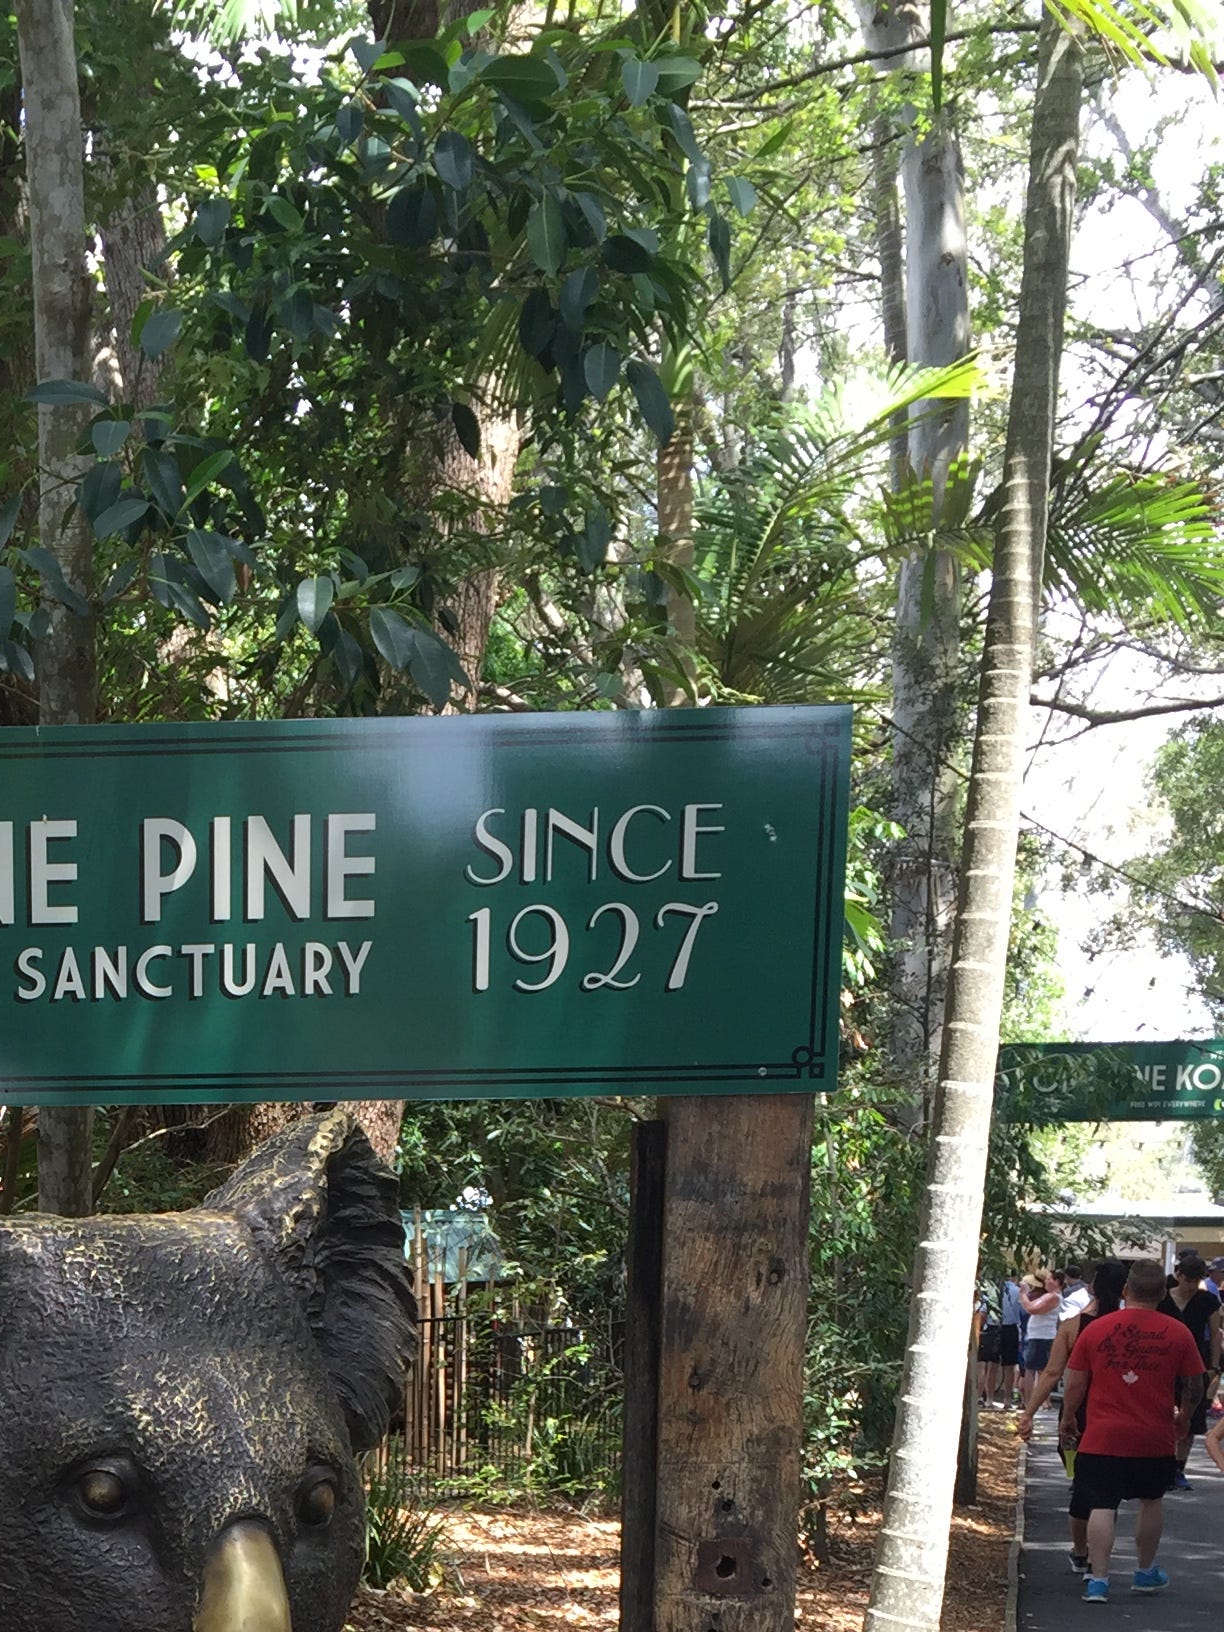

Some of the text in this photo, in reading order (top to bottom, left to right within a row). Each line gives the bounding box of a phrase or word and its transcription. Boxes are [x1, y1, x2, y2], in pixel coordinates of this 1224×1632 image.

[142, 812, 376, 922] PINE
[466, 803, 726, 885] SINCE
[16, 940, 373, 1001] SANCTUARY
[468, 901, 719, 992] 1927
[1175, 1063, 1224, 1091] KO
